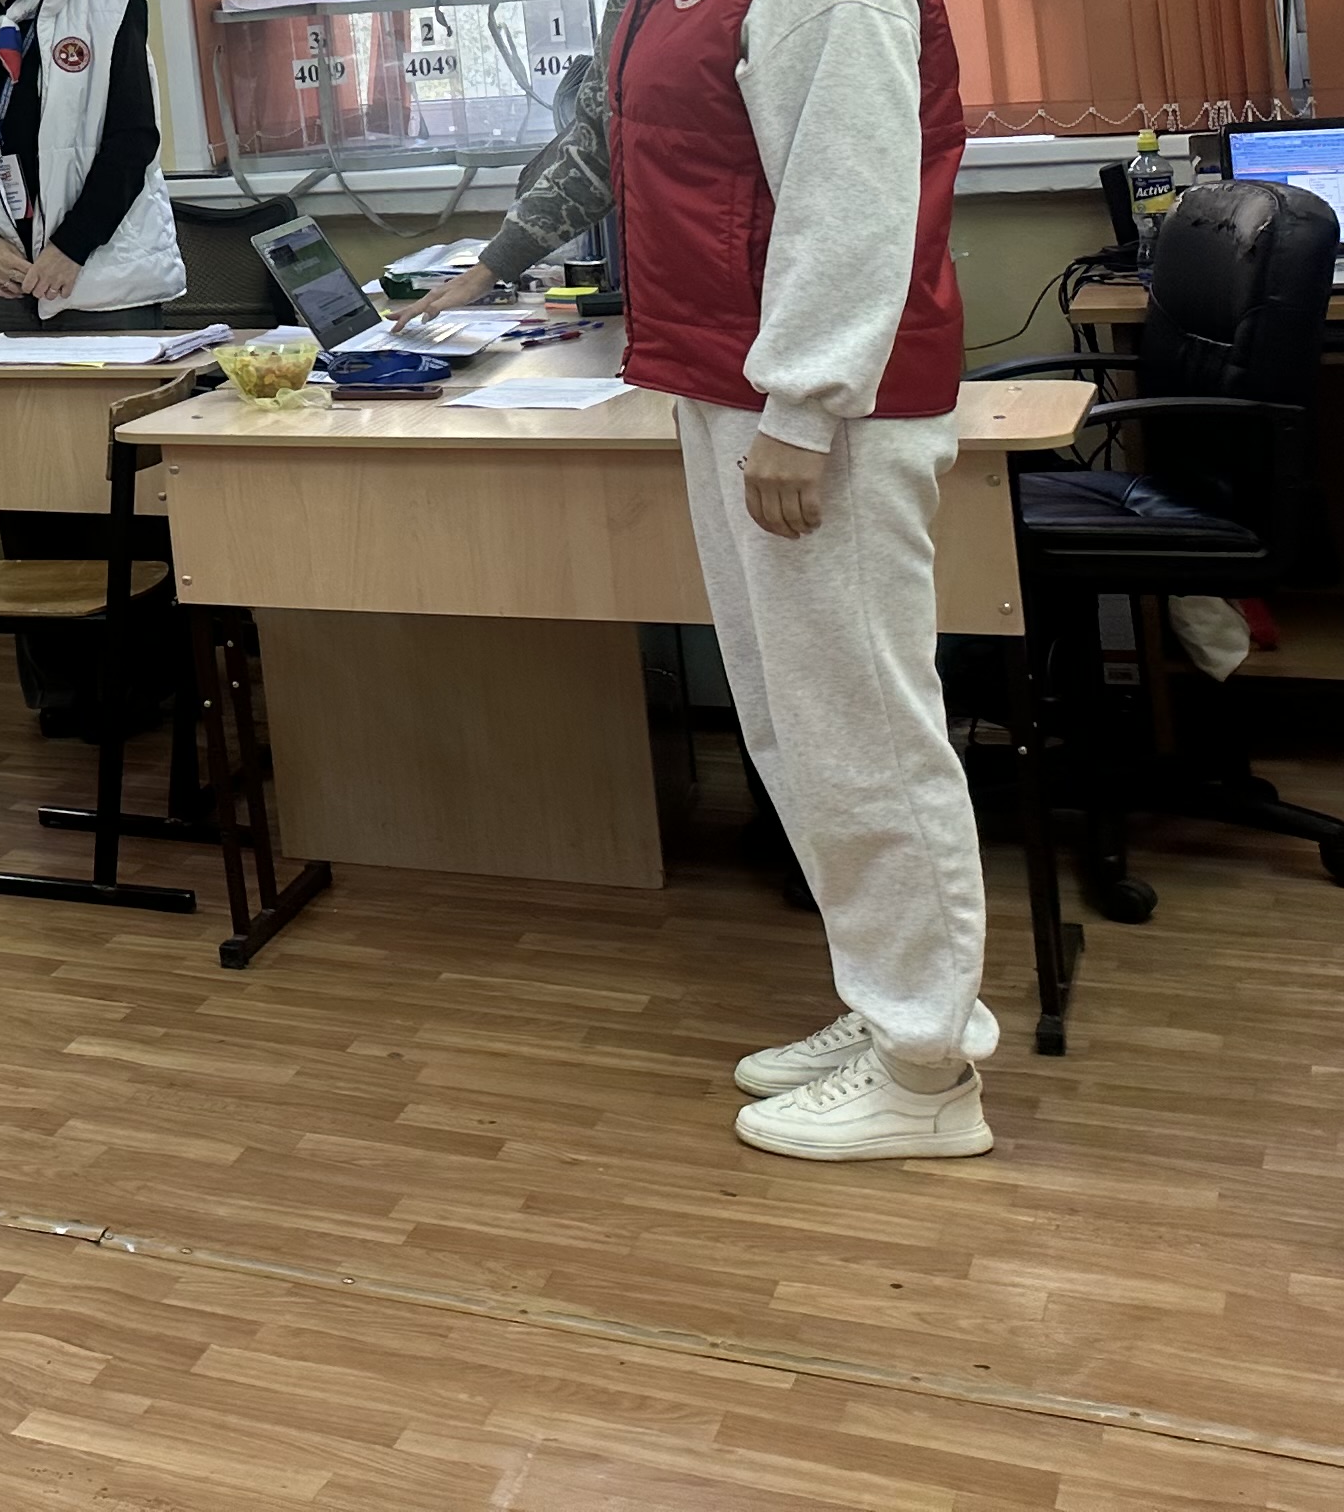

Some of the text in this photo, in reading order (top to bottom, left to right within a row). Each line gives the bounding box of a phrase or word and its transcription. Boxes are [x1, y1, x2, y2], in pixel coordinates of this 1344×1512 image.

[422, 23, 434, 41] 2
[552, 17, 563, 36] 1
[310, 32, 320, 49] 3
[295, 61, 345, 83] 409
[406, 55, 458, 76] 4049
[534, 54, 573, 75] 404
[1136, 184, 1170, 198] Active
